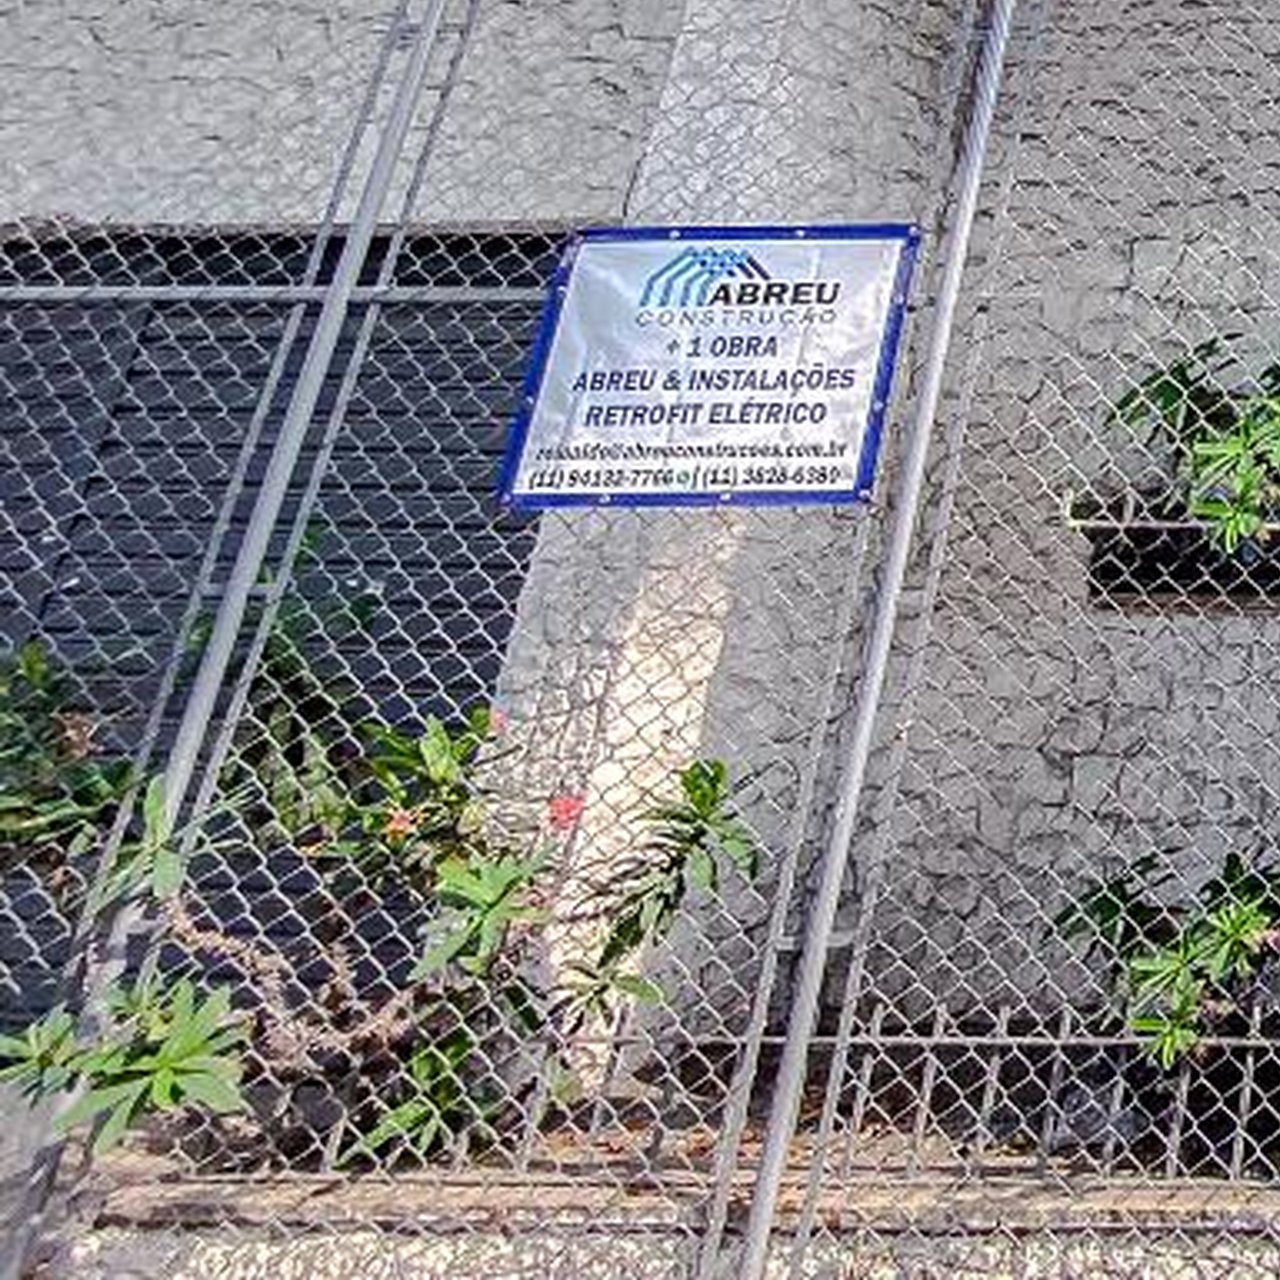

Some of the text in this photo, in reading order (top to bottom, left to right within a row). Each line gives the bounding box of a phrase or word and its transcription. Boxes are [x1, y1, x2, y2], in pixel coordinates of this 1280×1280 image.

[709, 282, 840, 306] ABREU
[635, 306, 837, 328] CONSTRUÇÃO
[687, 337, 701, 357] 1
[710, 336, 778, 357] OBRA
[573, 363, 855, 396] ABREU & INSTALAÇÕES
[585, 397, 828, 426] RETROFIT ELÉTRICO
[529, 470, 565, 489] (11)
[703, 467, 737, 487] (11)
